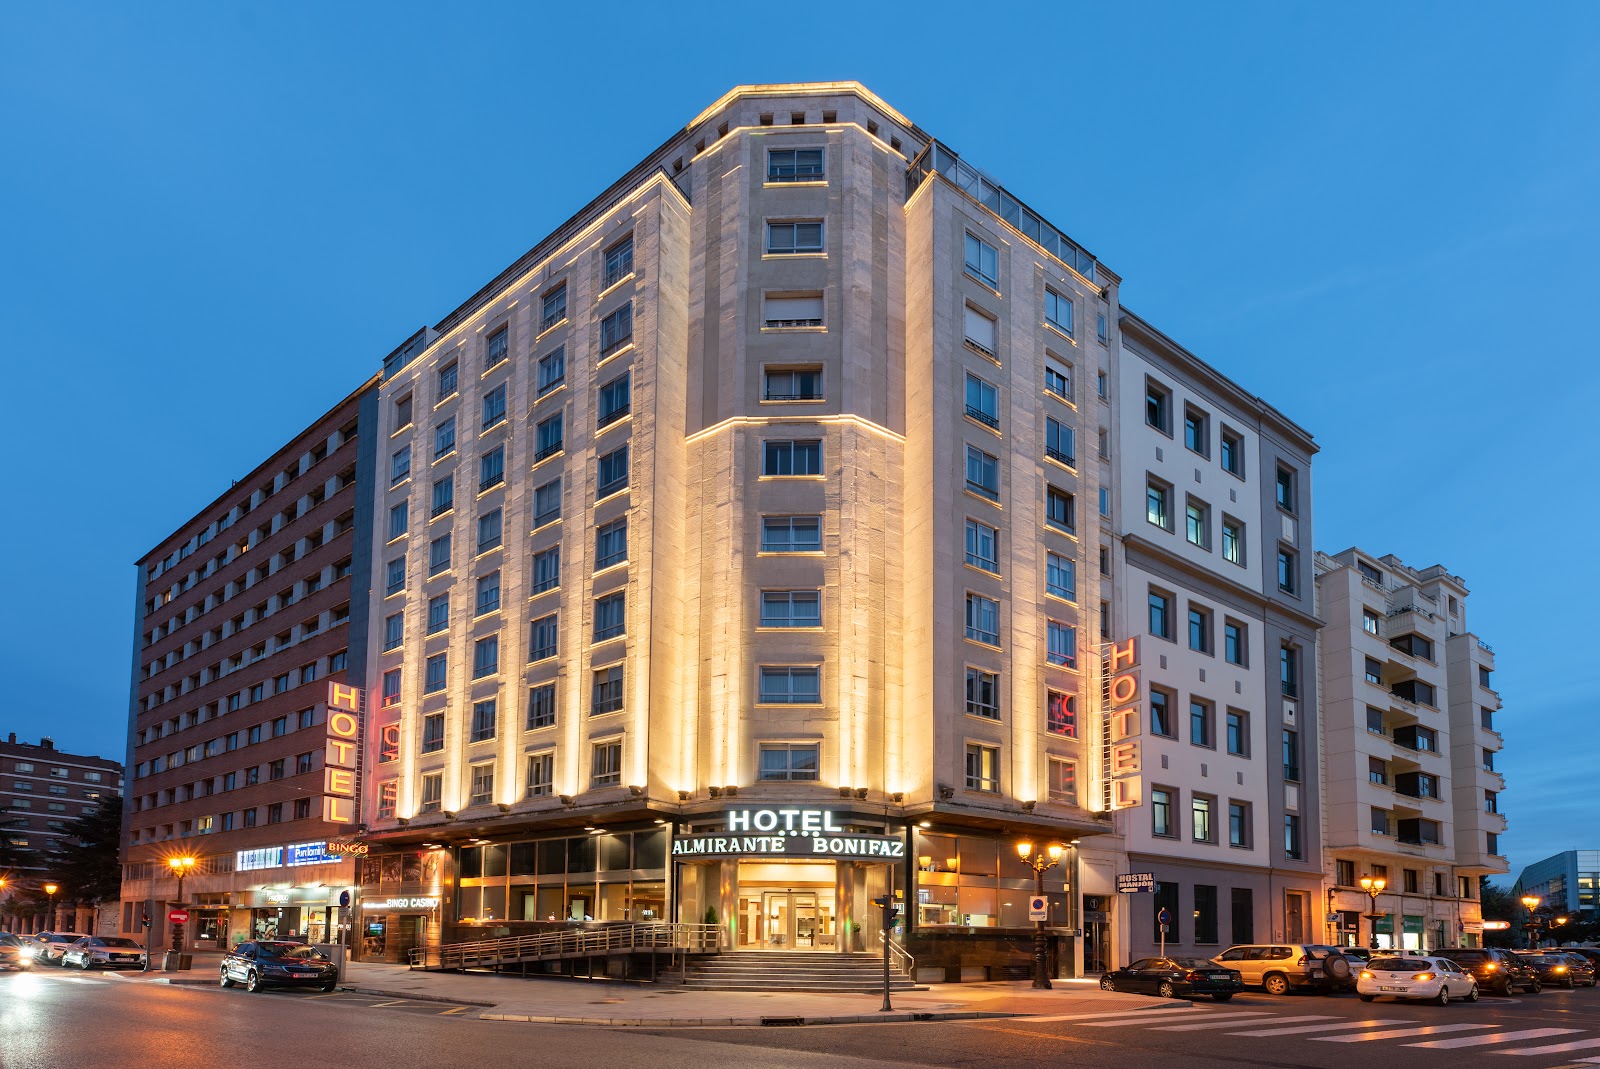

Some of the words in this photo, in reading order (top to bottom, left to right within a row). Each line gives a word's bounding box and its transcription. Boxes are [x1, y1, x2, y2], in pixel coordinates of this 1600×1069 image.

[1111, 637, 1138, 807] HOTEL
[330, 683, 357, 822] HOTEL
[729, 809, 842, 832] HOTEL
[328, 842, 369, 854] BINGO
[672, 836, 786, 855] ALMIRANTE
[812, 837, 904, 857] BONIFAZ
[1119, 873, 1154, 882] HOSTAL
[386, 898, 409, 908] BINGO
[410, 898, 439, 908] CASINO
